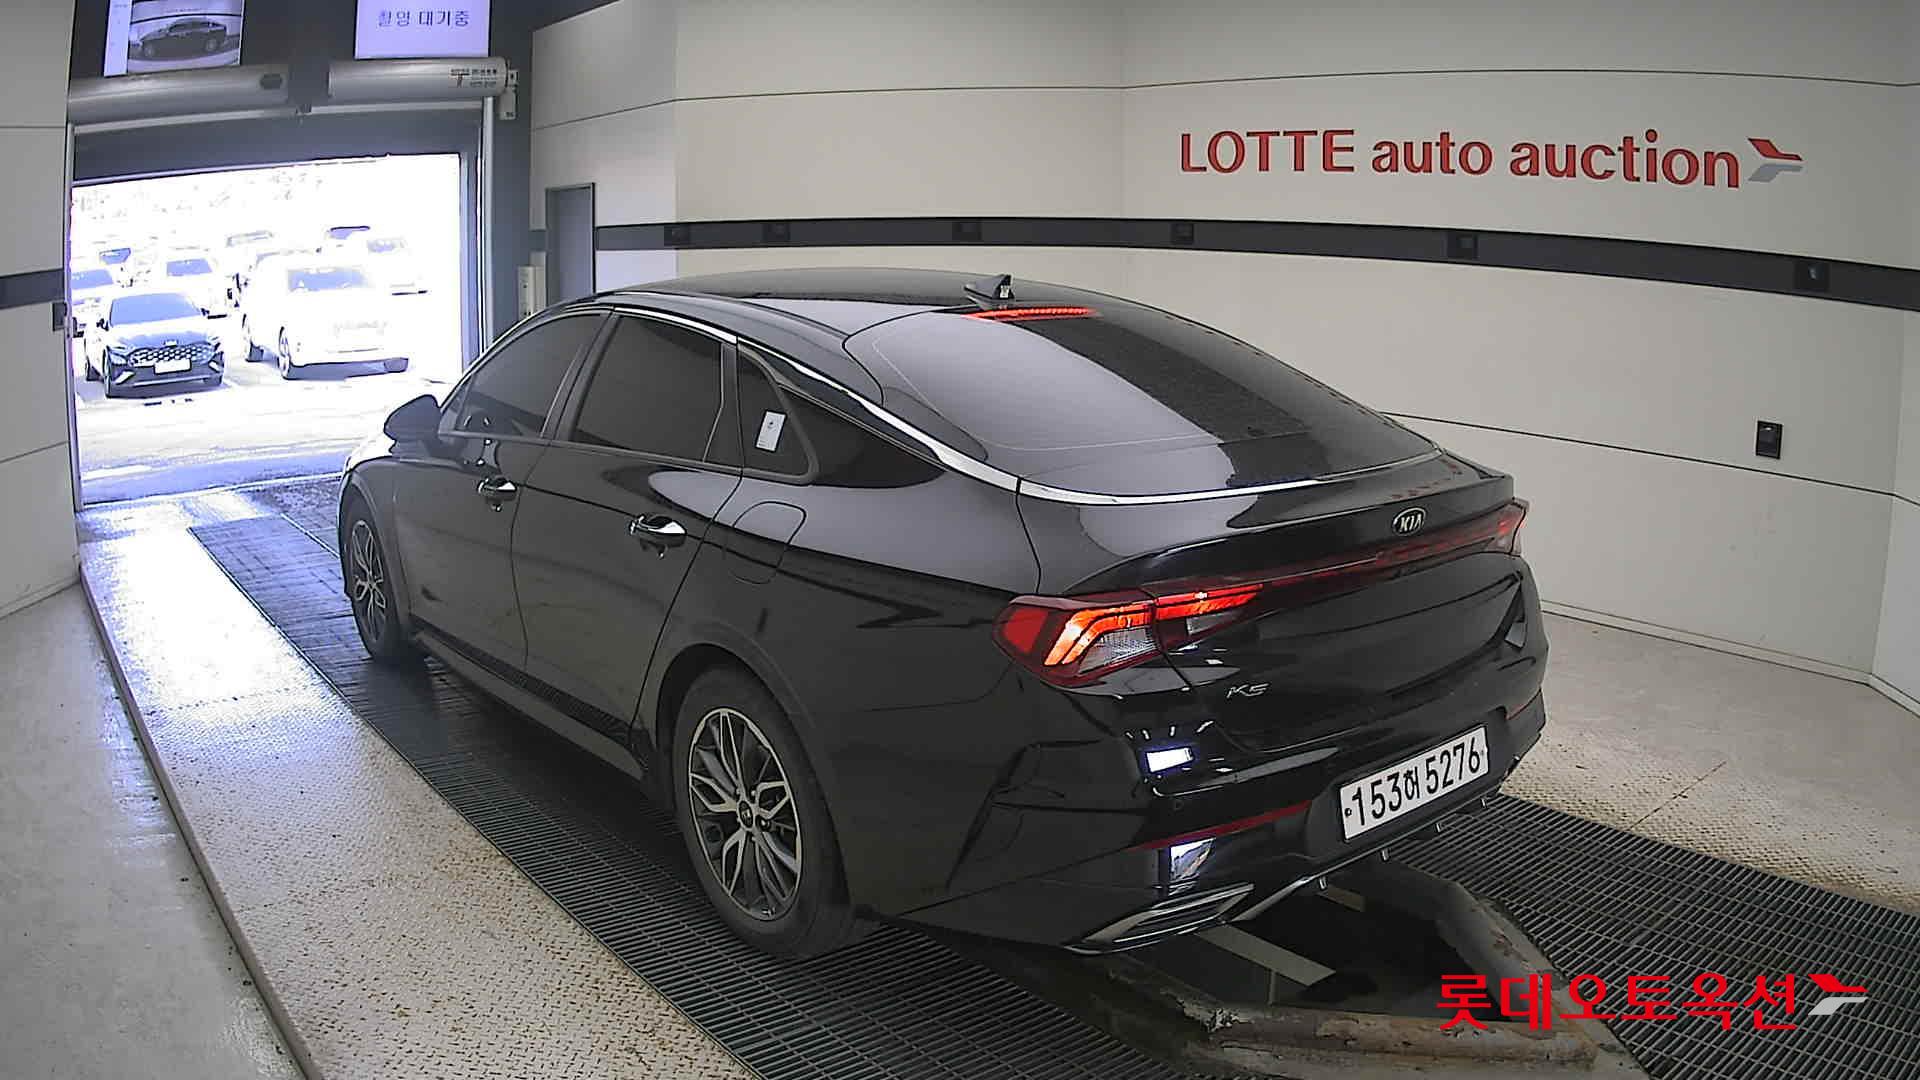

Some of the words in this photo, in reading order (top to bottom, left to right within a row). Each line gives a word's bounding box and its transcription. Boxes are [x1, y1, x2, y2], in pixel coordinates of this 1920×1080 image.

[418, 9, 470, 27] 대기중
[1180, 128, 1355, 174] LOTTE
[1371, 131, 1493, 176] auto
[1509, 128, 1741, 189] auction
[1398, 510, 1424, 532] KIA
[1226, 683, 1270, 698] K5
[1351, 766, 1420, 826] 153허
[1425, 737, 1481, 794] 5276
